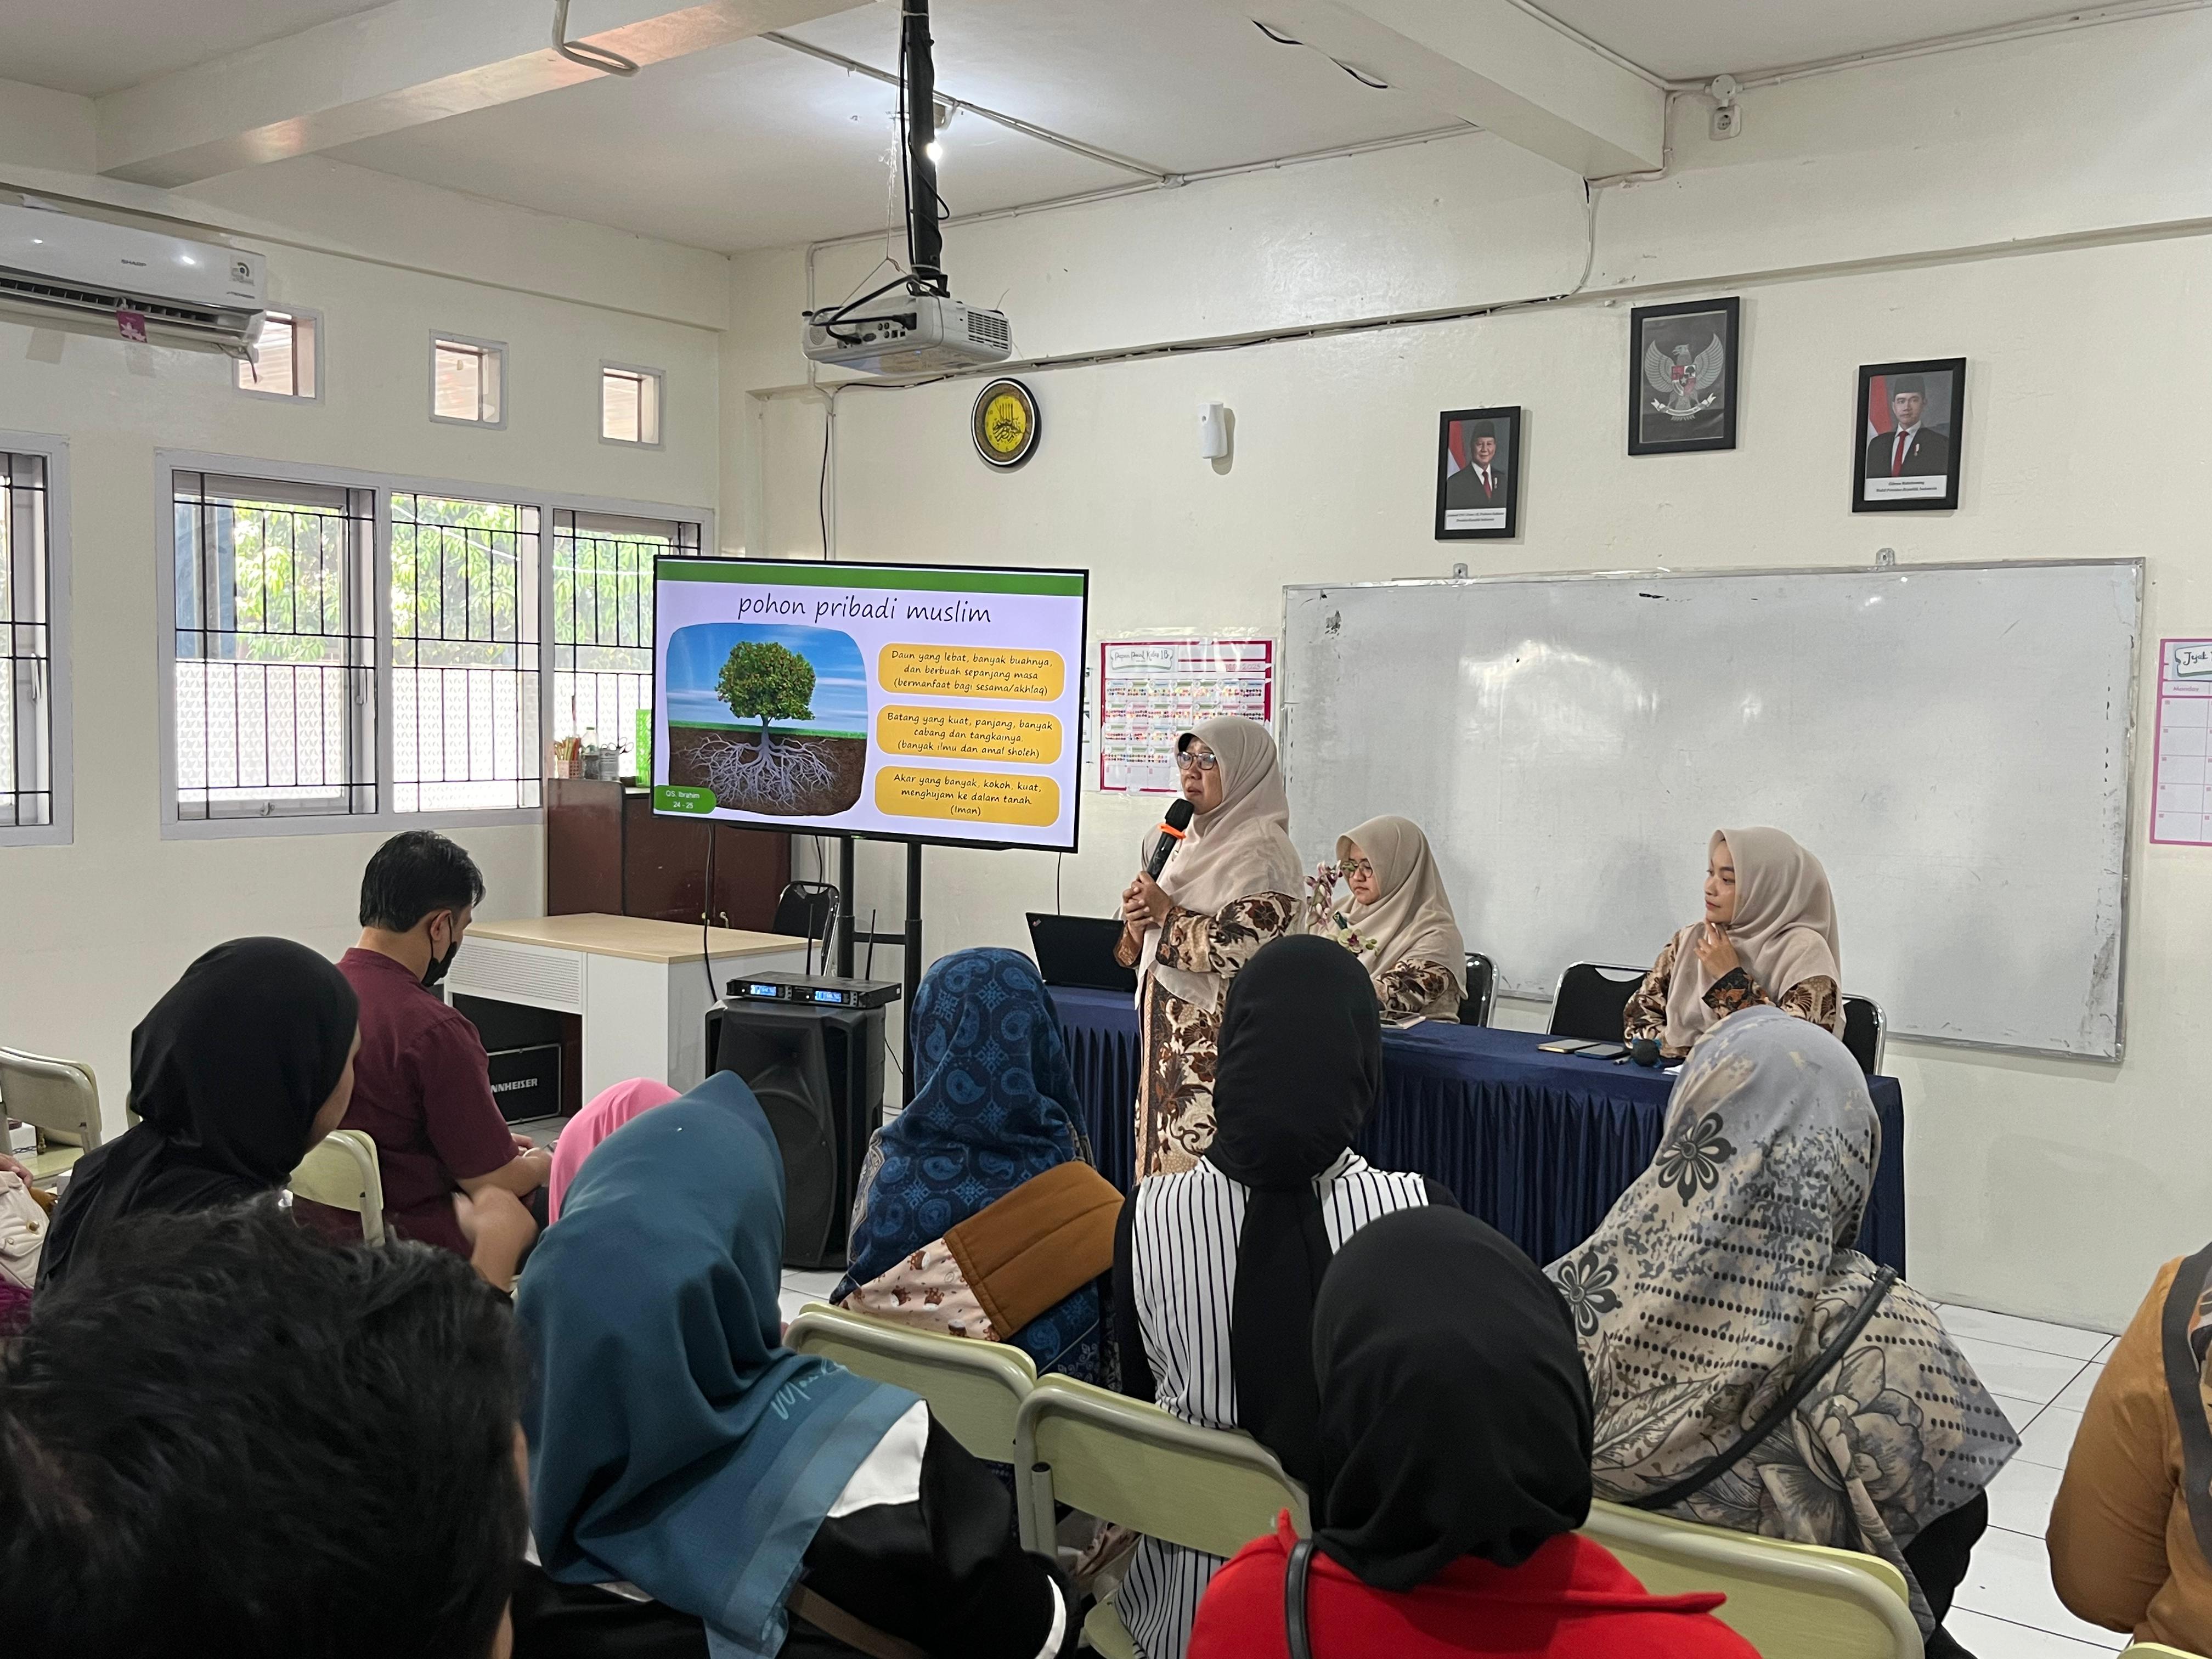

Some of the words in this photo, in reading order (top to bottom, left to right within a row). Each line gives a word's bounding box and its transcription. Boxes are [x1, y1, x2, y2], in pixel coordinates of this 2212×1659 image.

[738, 592, 805, 620] pohon
[815, 595, 898, 623] pribadi
[907, 600, 991, 622] muslim
[891, 651, 915, 659] Daun
[919, 653, 940, 663] yang
[944, 652, 969, 663] lebat,
[973, 653, 1006, 666] banyak
[1010, 655, 1053, 668] buahnya,
[904, 664, 921, 674] dan
[925, 665, 961, 675] berbuah
[964, 669, 1010, 681] sepanjang
[894, 678, 950, 689] (bermanfaat
[954, 681, 973, 693] bagi
[976, 684, 1048, 697] sesama/akhlaq)
[887, 713, 919, 725] Batang
[923, 716, 945, 726] yang
[948, 715, 971, 726] kuat,
[975, 719, 1015, 730] panjang,
[1019, 719, 1053, 731] banyak
[914, 727, 945, 740] cabang
[949, 730, 967, 738] dan
[898, 740, 934, 752] (banyak
[937, 742, 957, 752] ilmu
[961, 744, 978, 753] dan
[1007, 747, 1040, 759] sholeh)
[894, 774, 916, 782] Akar
[919, 777, 941, 787] yang
[944, 776, 980, 789] banyak,
[984, 779, 1014, 790] kokoh,
[1017, 781, 1042, 792] kuat,
[901, 789, 954, 801] menghujam
[957, 790, 968, 800] ke
[971, 792, 1000, 802] dalam
[1003, 795, 1032, 805] tanah.
[950, 804, 981, 816] (Iman)
[491, 1078, 538, 1093] NNHEISER
